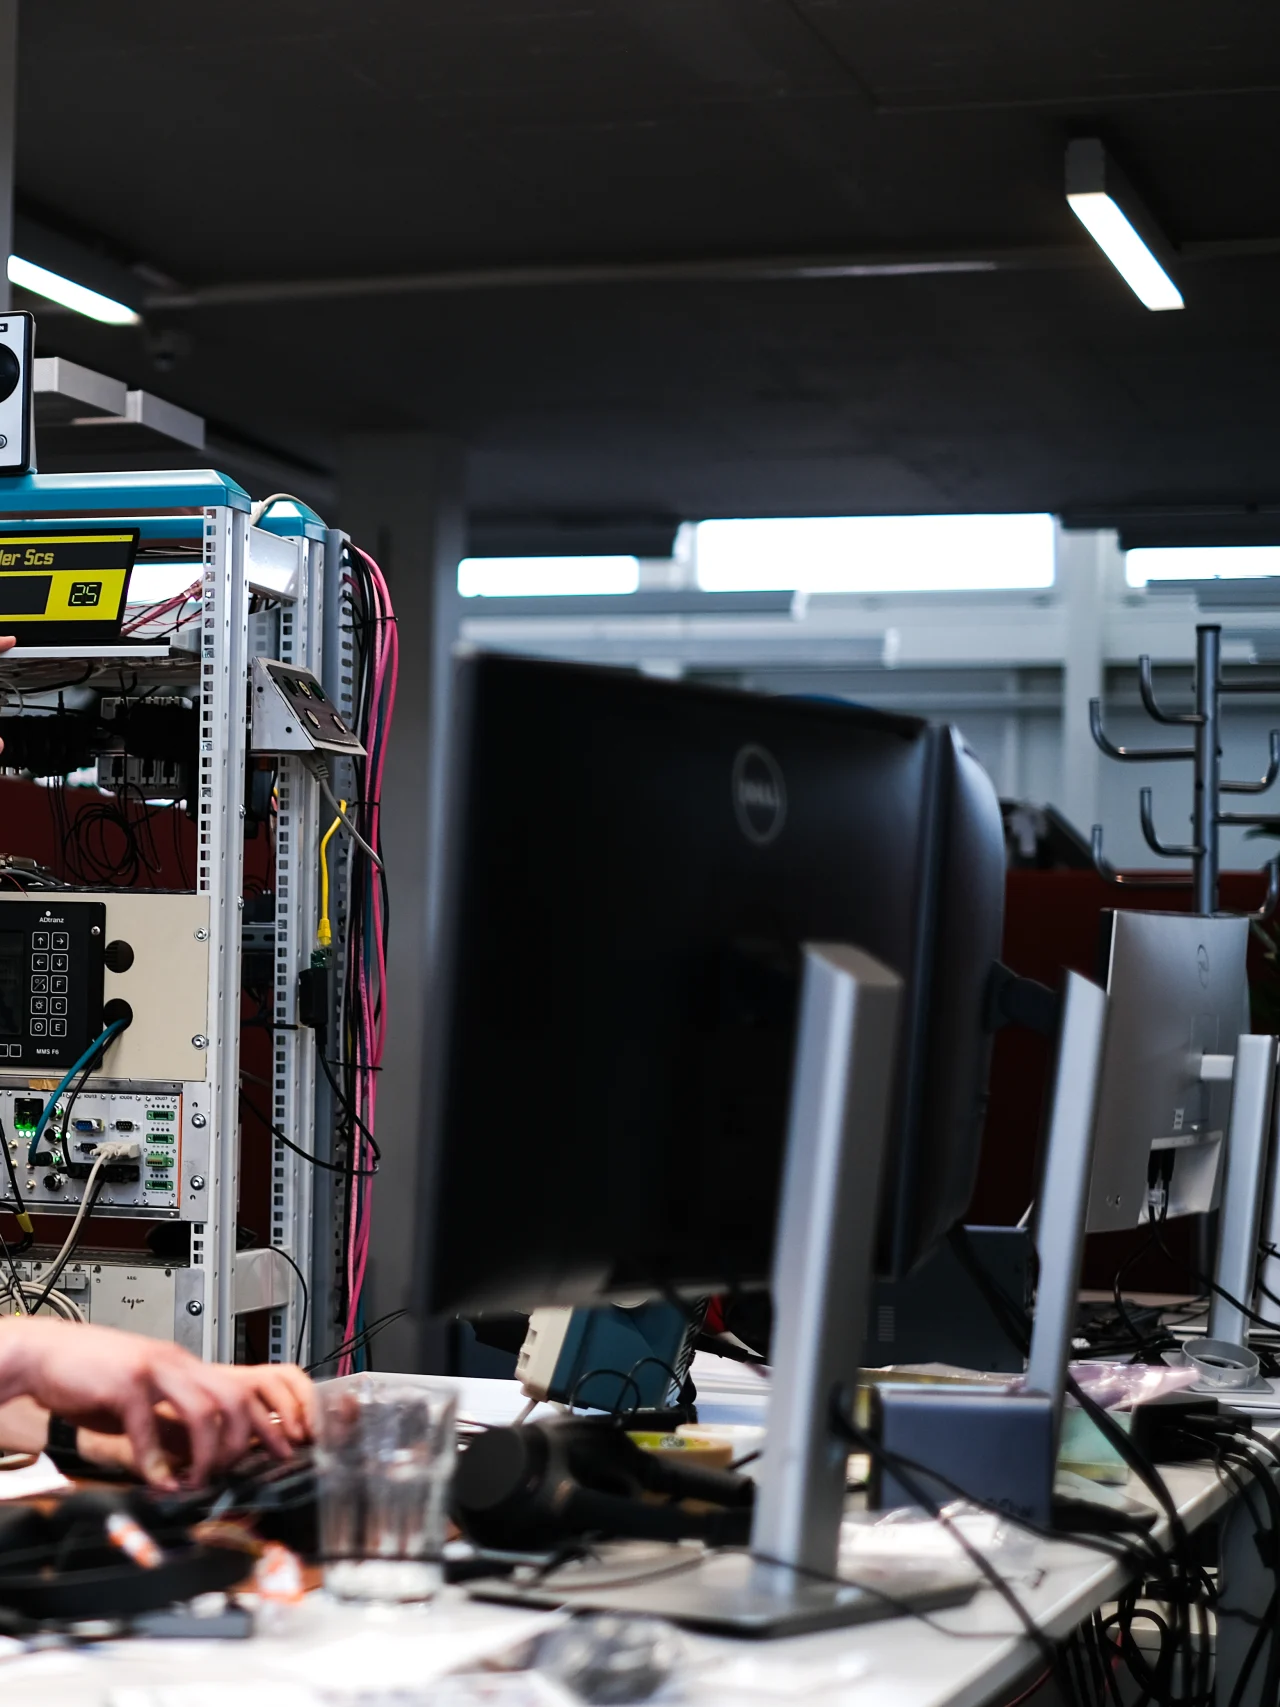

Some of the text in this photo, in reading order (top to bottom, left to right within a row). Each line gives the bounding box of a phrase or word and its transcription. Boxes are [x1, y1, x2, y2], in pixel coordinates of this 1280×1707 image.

[24, 549, 54, 566] Scs
[71, 584, 98, 605] 25
[56, 980, 62, 988] F
[55, 1002, 62, 1010] C
